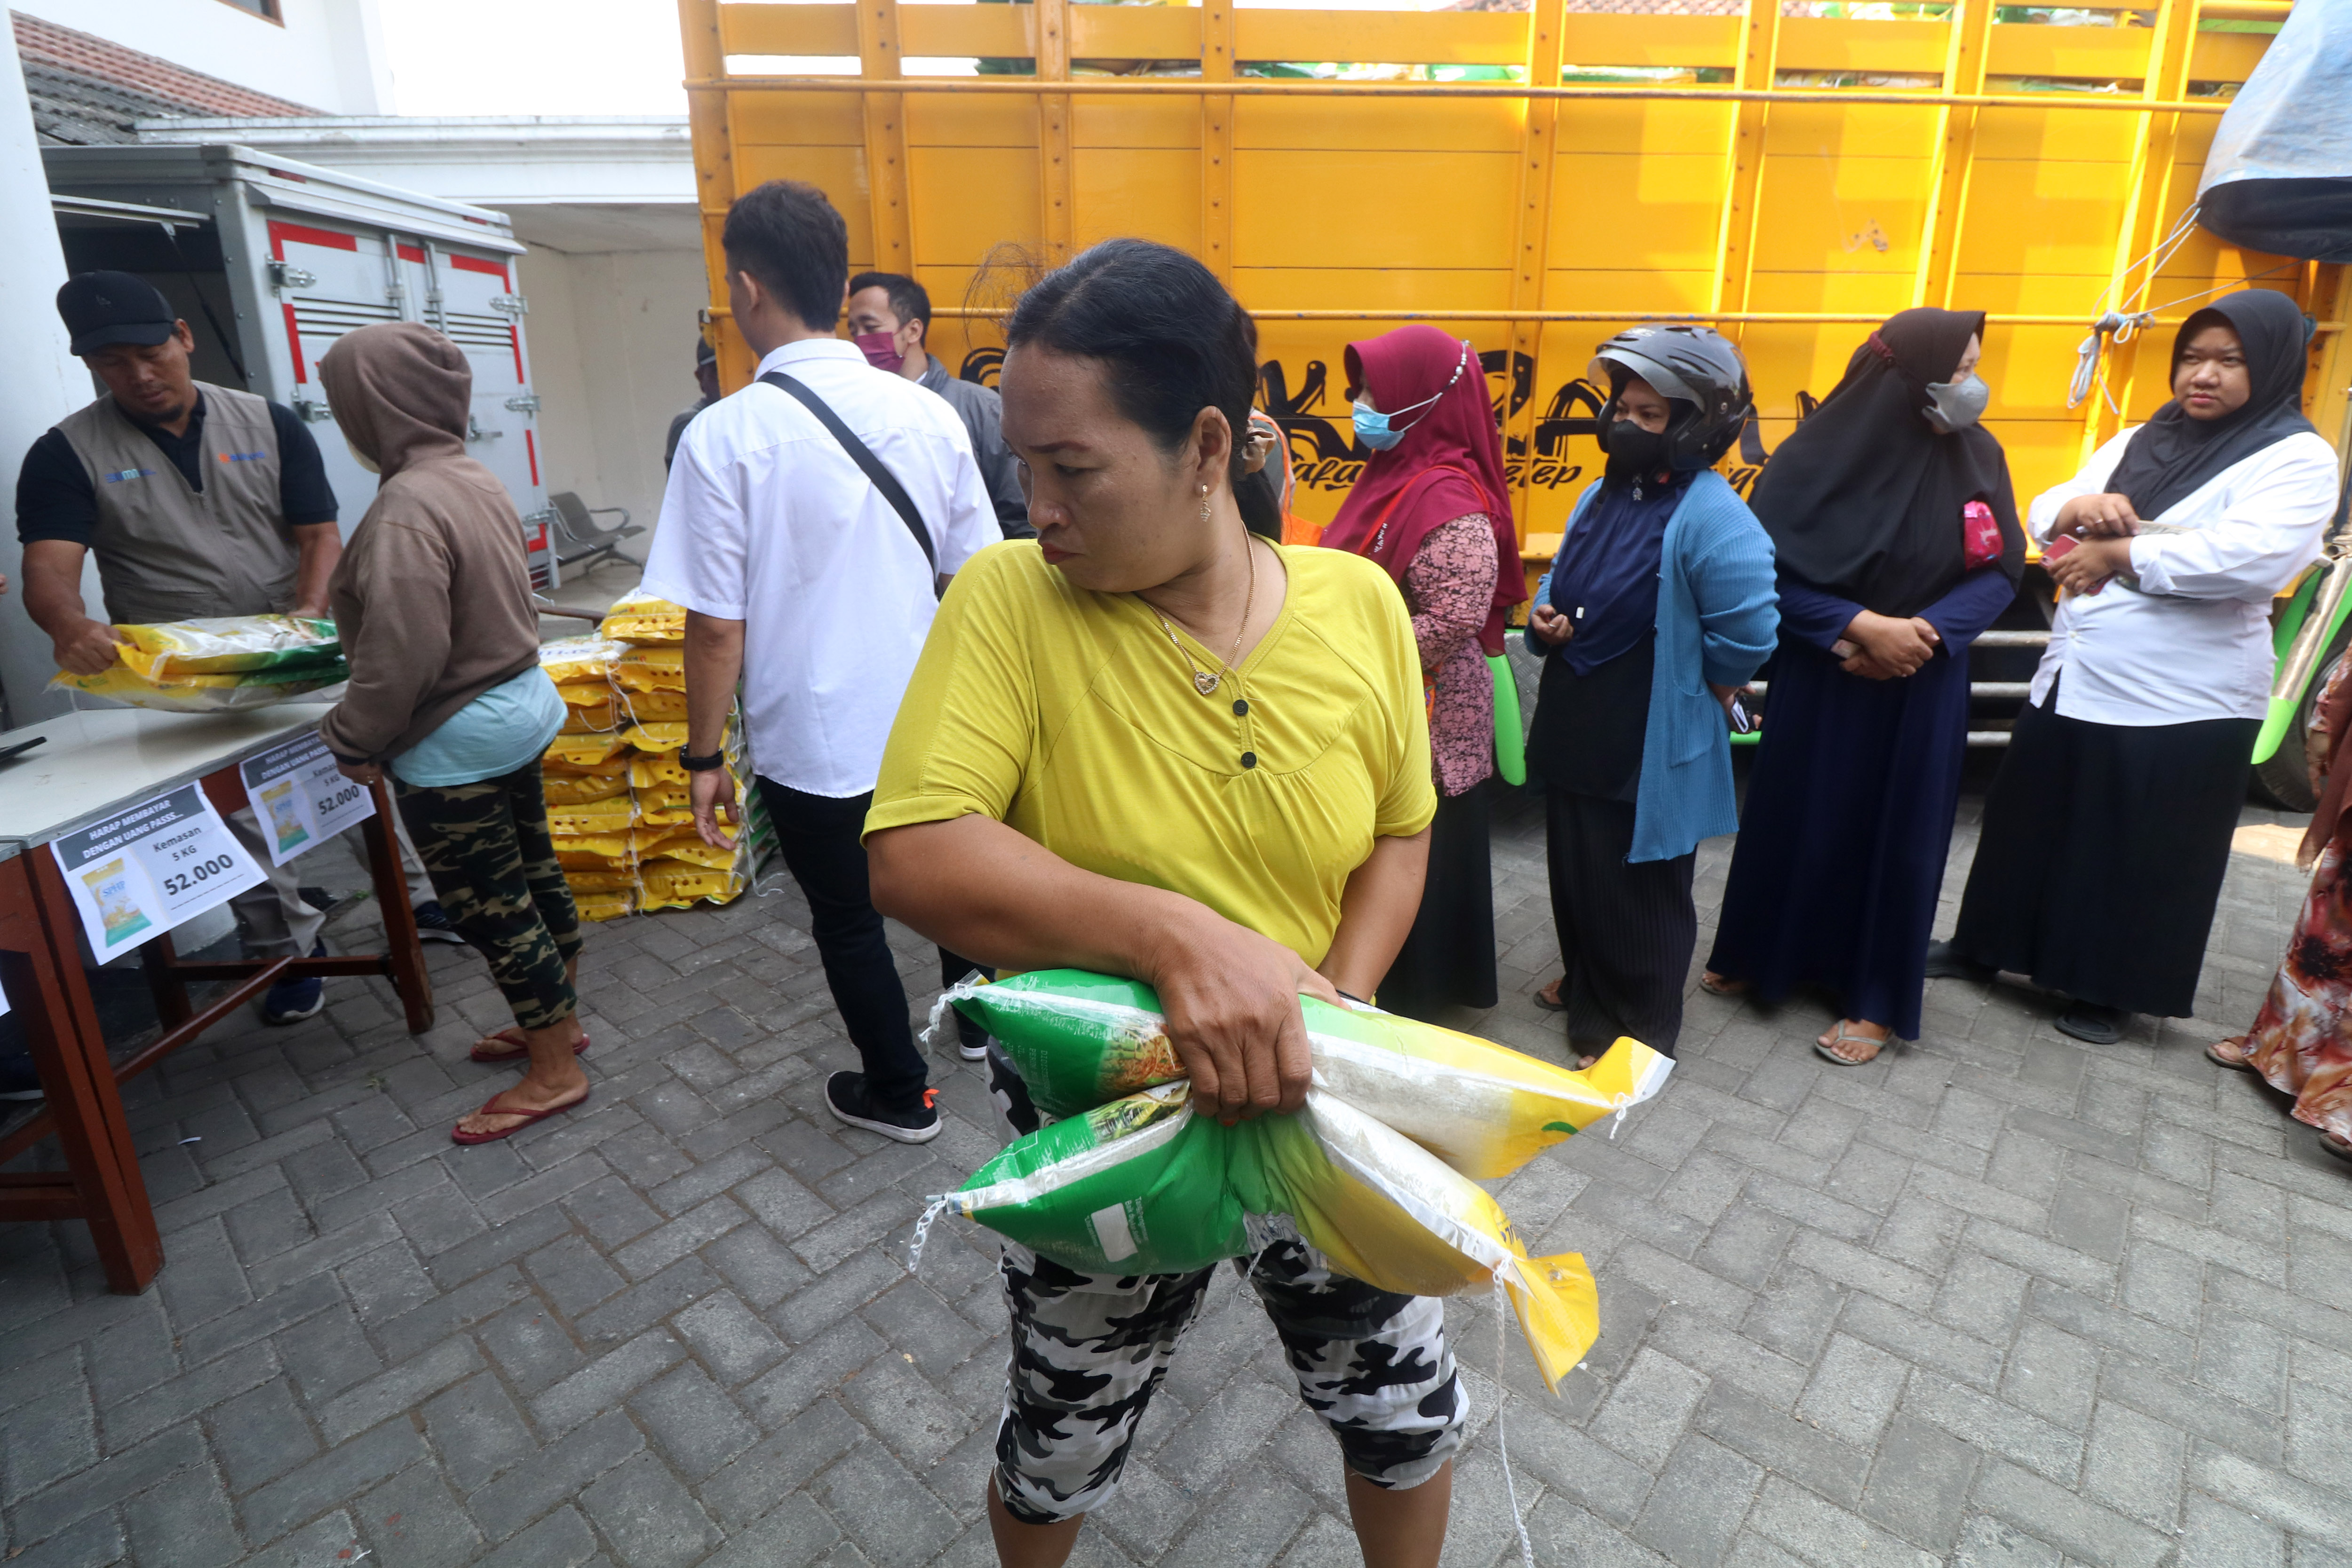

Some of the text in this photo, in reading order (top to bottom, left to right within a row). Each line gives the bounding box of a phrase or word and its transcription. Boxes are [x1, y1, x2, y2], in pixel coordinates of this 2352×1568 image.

[318, 785, 359, 815] 52.000
[89, 800, 172, 840] HARAP MEMBAYAR
[83, 836, 123, 859] DENGAN
[125, 824, 151, 841] UANG
[153, 826, 202, 853] Kemasan
[172, 846, 197, 862] 5 KG
[164, 854, 234, 896] 52.000
